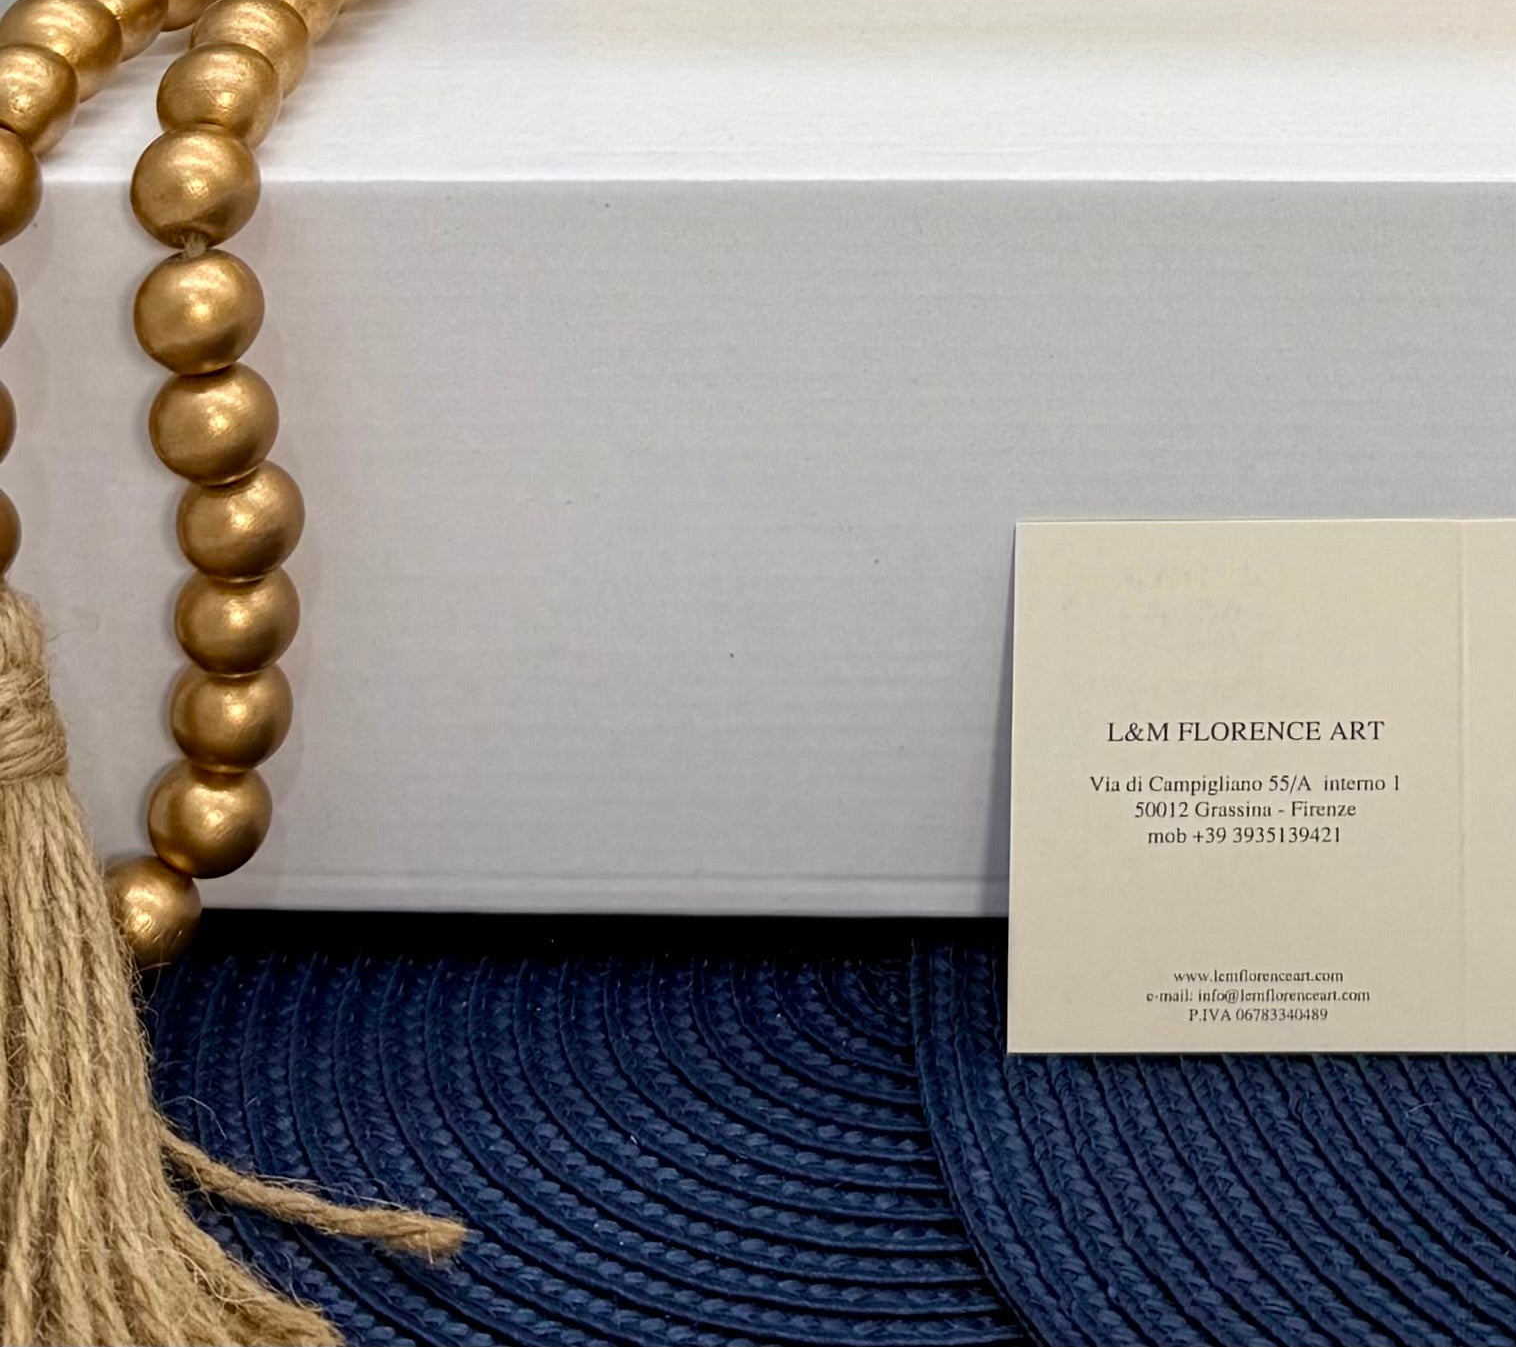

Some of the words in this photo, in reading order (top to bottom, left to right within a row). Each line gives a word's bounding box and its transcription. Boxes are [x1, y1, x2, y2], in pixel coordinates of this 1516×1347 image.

[1107, 722, 1169, 742] L&M
[1178, 721, 1321, 741] FLORENCE
[1330, 721, 1385, 740] ART
[1090, 776, 1120, 792] Via
[1126, 776, 1142, 792] di
[1149, 775, 1263, 796] Campigliano
[1269, 775, 1312, 794] 55/A
[1324, 775, 1386, 791] interno
[1394, 775, 1400, 791] 1
[1135, 802, 1188, 818] 50012
[1195, 801, 1272, 817] Grassina
[1291, 801, 1356, 817] Firenze
[1148, 828, 1187, 844] mob
[1192, 827, 1226, 843] +39
[1233, 827, 1340, 843] 3935139421
[1189, 1008, 1231, 1021] P.IVA
[1236, 1008, 1327, 1021] 06783340489
